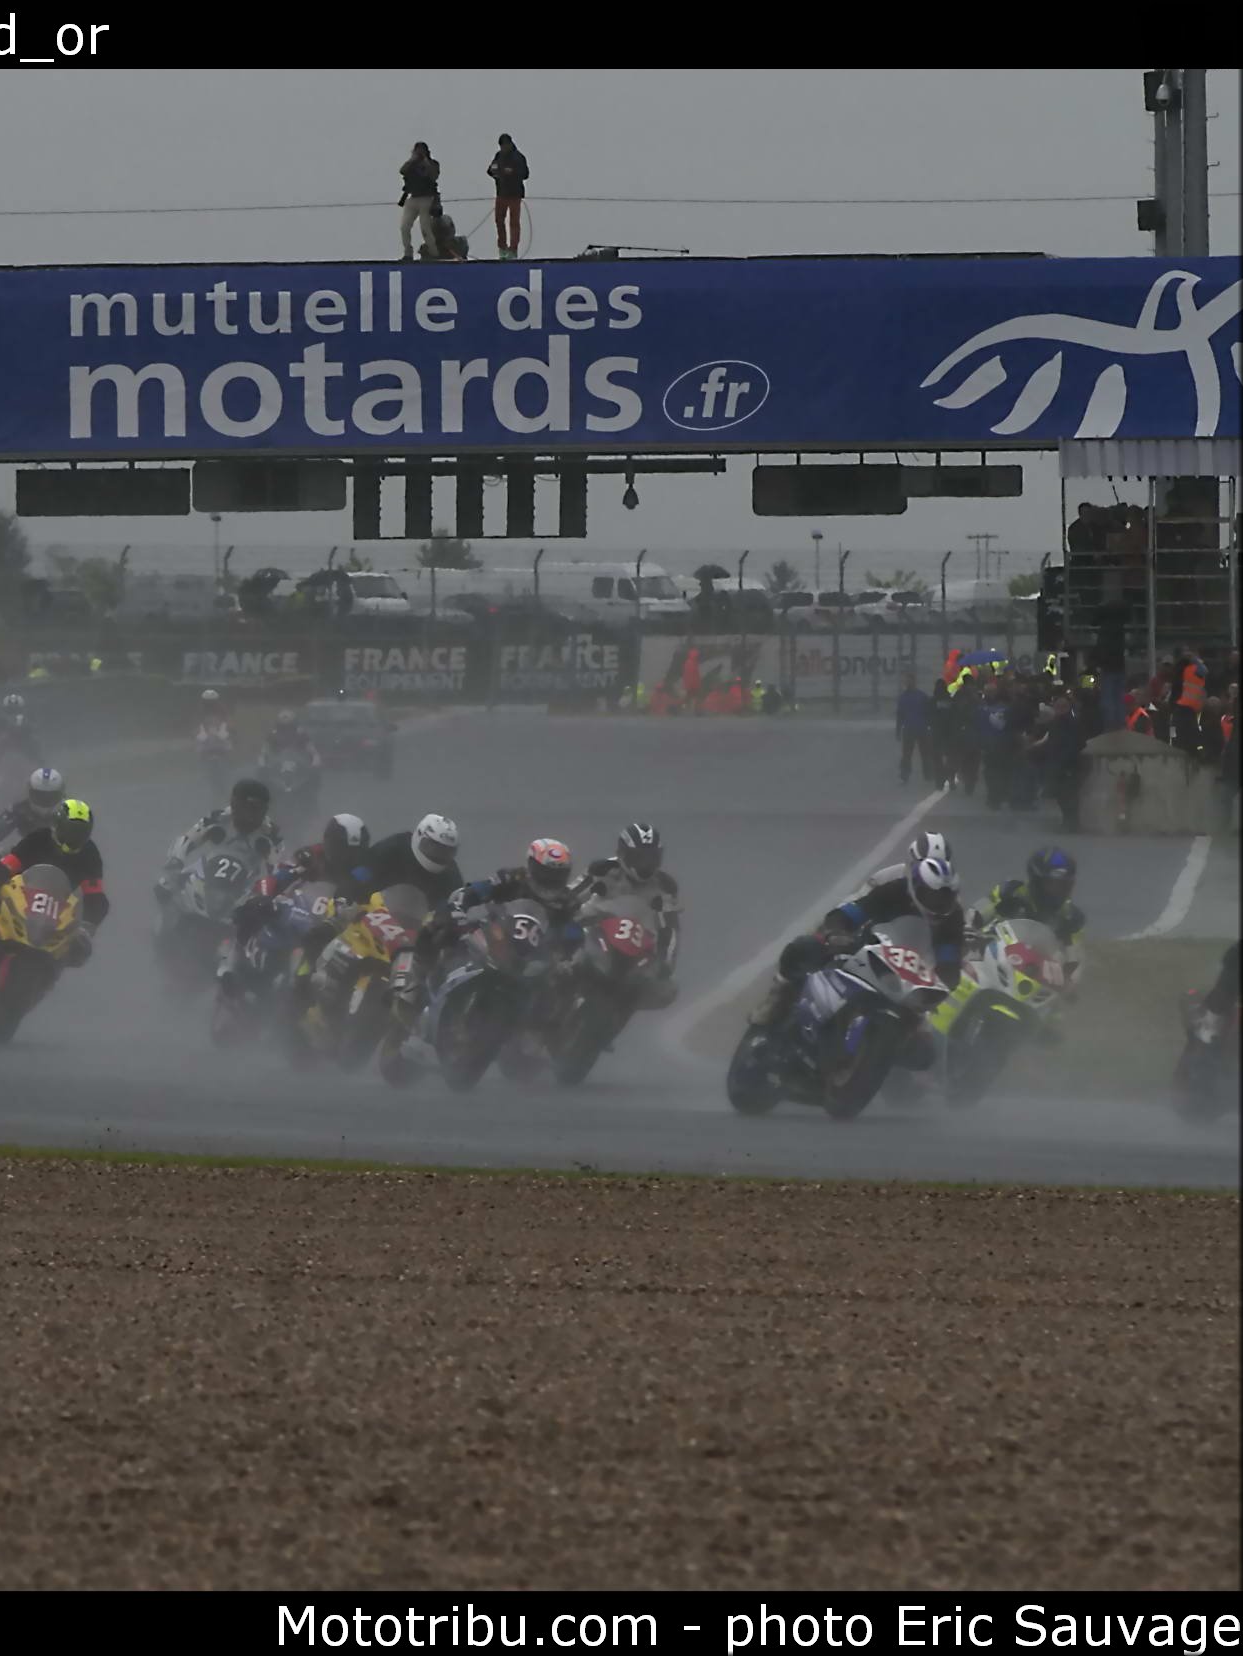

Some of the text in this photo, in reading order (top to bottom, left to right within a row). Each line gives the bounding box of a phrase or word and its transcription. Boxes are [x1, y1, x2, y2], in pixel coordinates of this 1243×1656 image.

[69, 268, 642, 336] mutuelle des
[69, 334, 750, 438] motards .fr
[182, 650, 300, 675] FRANCE
[345, 647, 466, 671] FRANCE
[214, 857, 242, 882] 27
